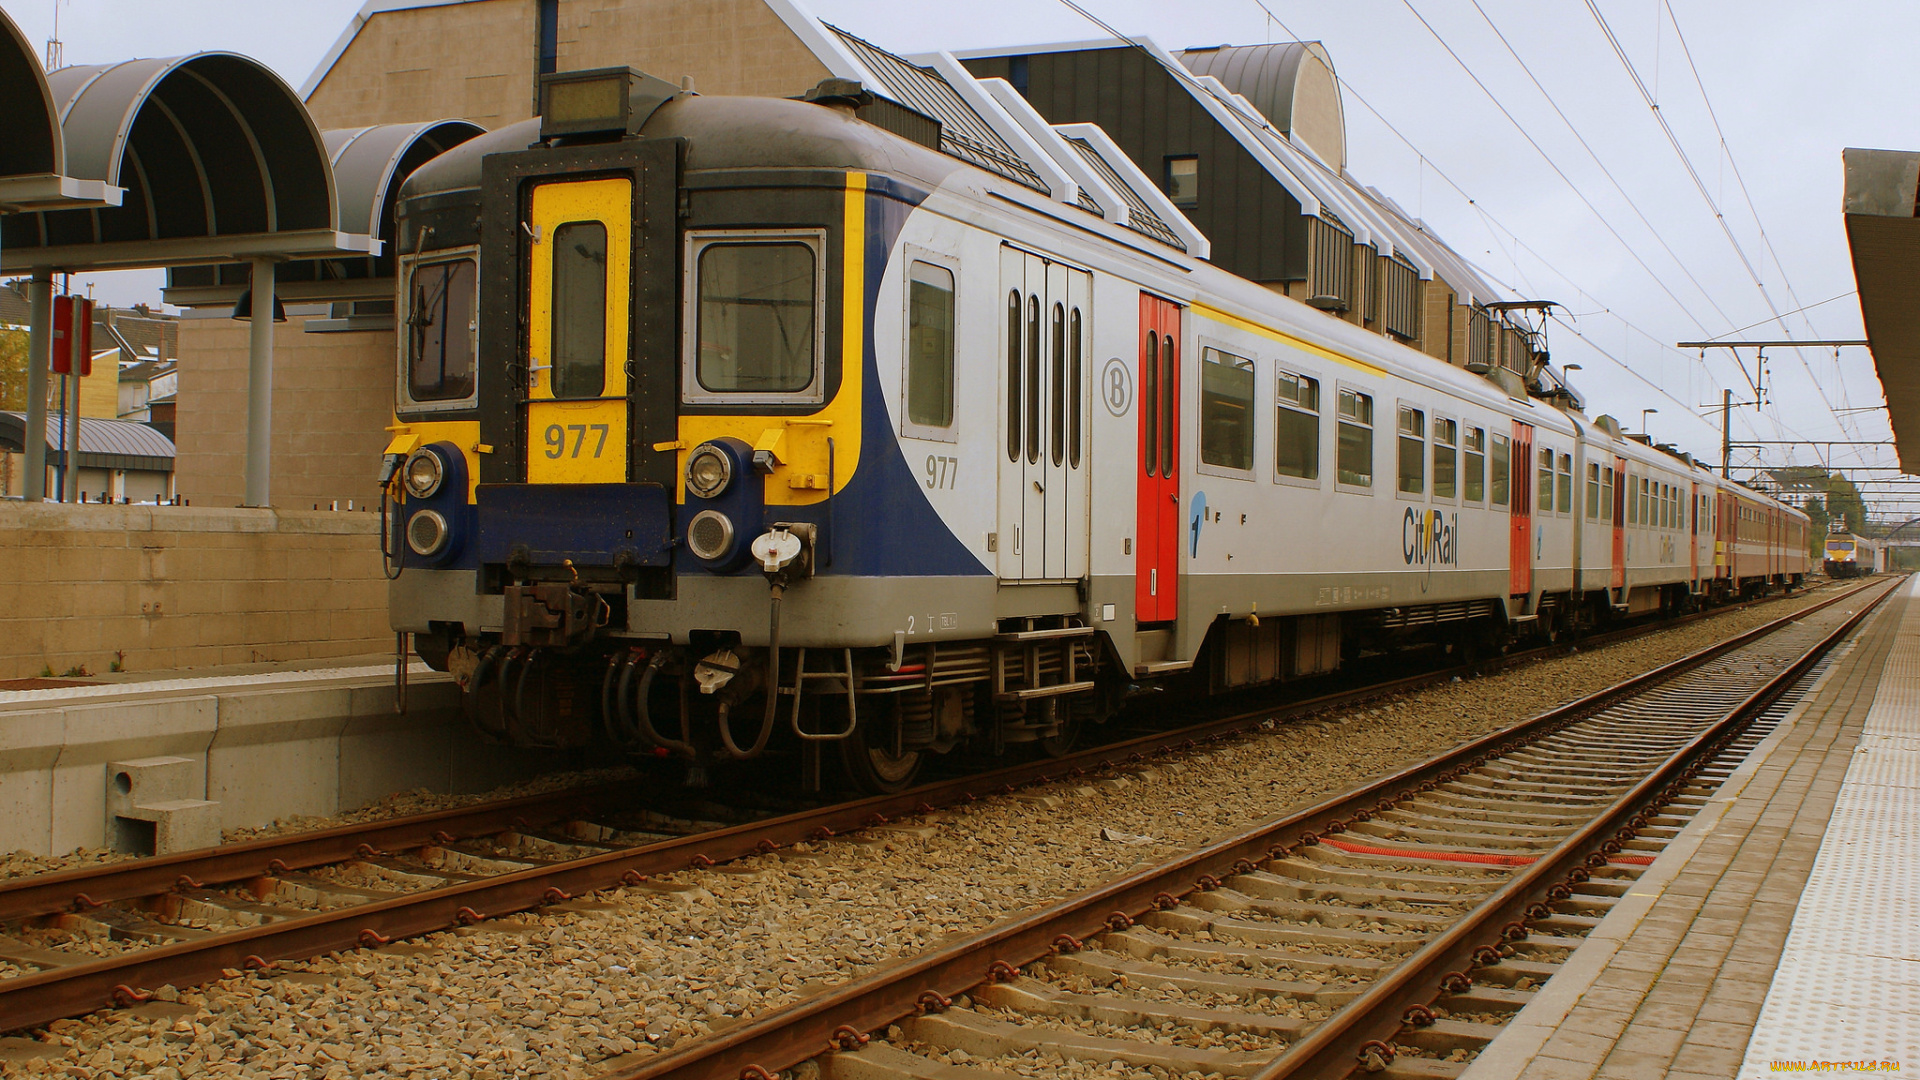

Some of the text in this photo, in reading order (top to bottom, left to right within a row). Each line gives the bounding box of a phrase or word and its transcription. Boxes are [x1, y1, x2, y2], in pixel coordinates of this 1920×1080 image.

[545, 424, 609, 459] 977
[926, 454, 958, 490] 977
[1403, 506, 1458, 590] CityRail
[907, 615, 915, 635] 2
